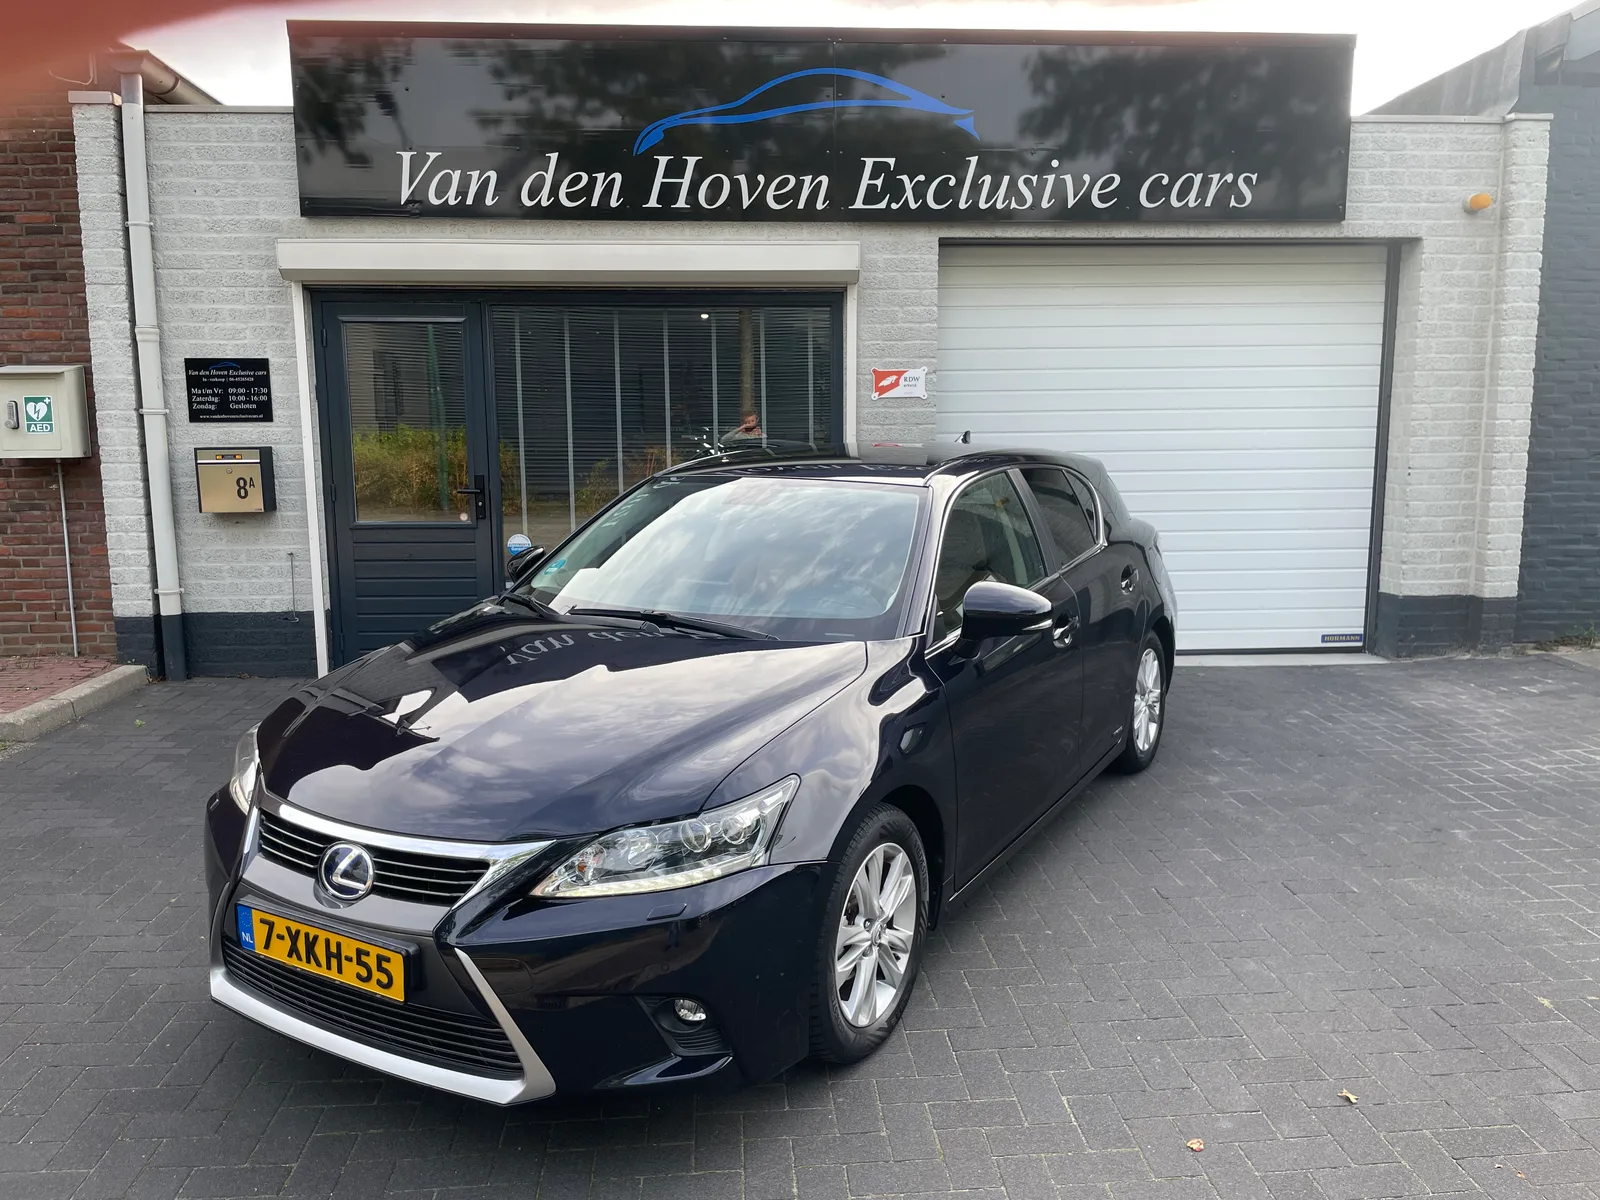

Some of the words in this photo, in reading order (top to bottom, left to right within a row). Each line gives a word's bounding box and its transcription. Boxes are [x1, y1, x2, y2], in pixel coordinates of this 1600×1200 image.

[396, 150, 499, 207] Van
[520, 151, 624, 208] den
[642, 155, 830, 210] Hoven
[848, 155, 1121, 210] Exclusive
[1139, 171, 1259, 209] cars
[30, 424, 51, 432] AED
[241, 931, 254, 944] NL
[259, 917, 394, 990] 7-XKH-55
